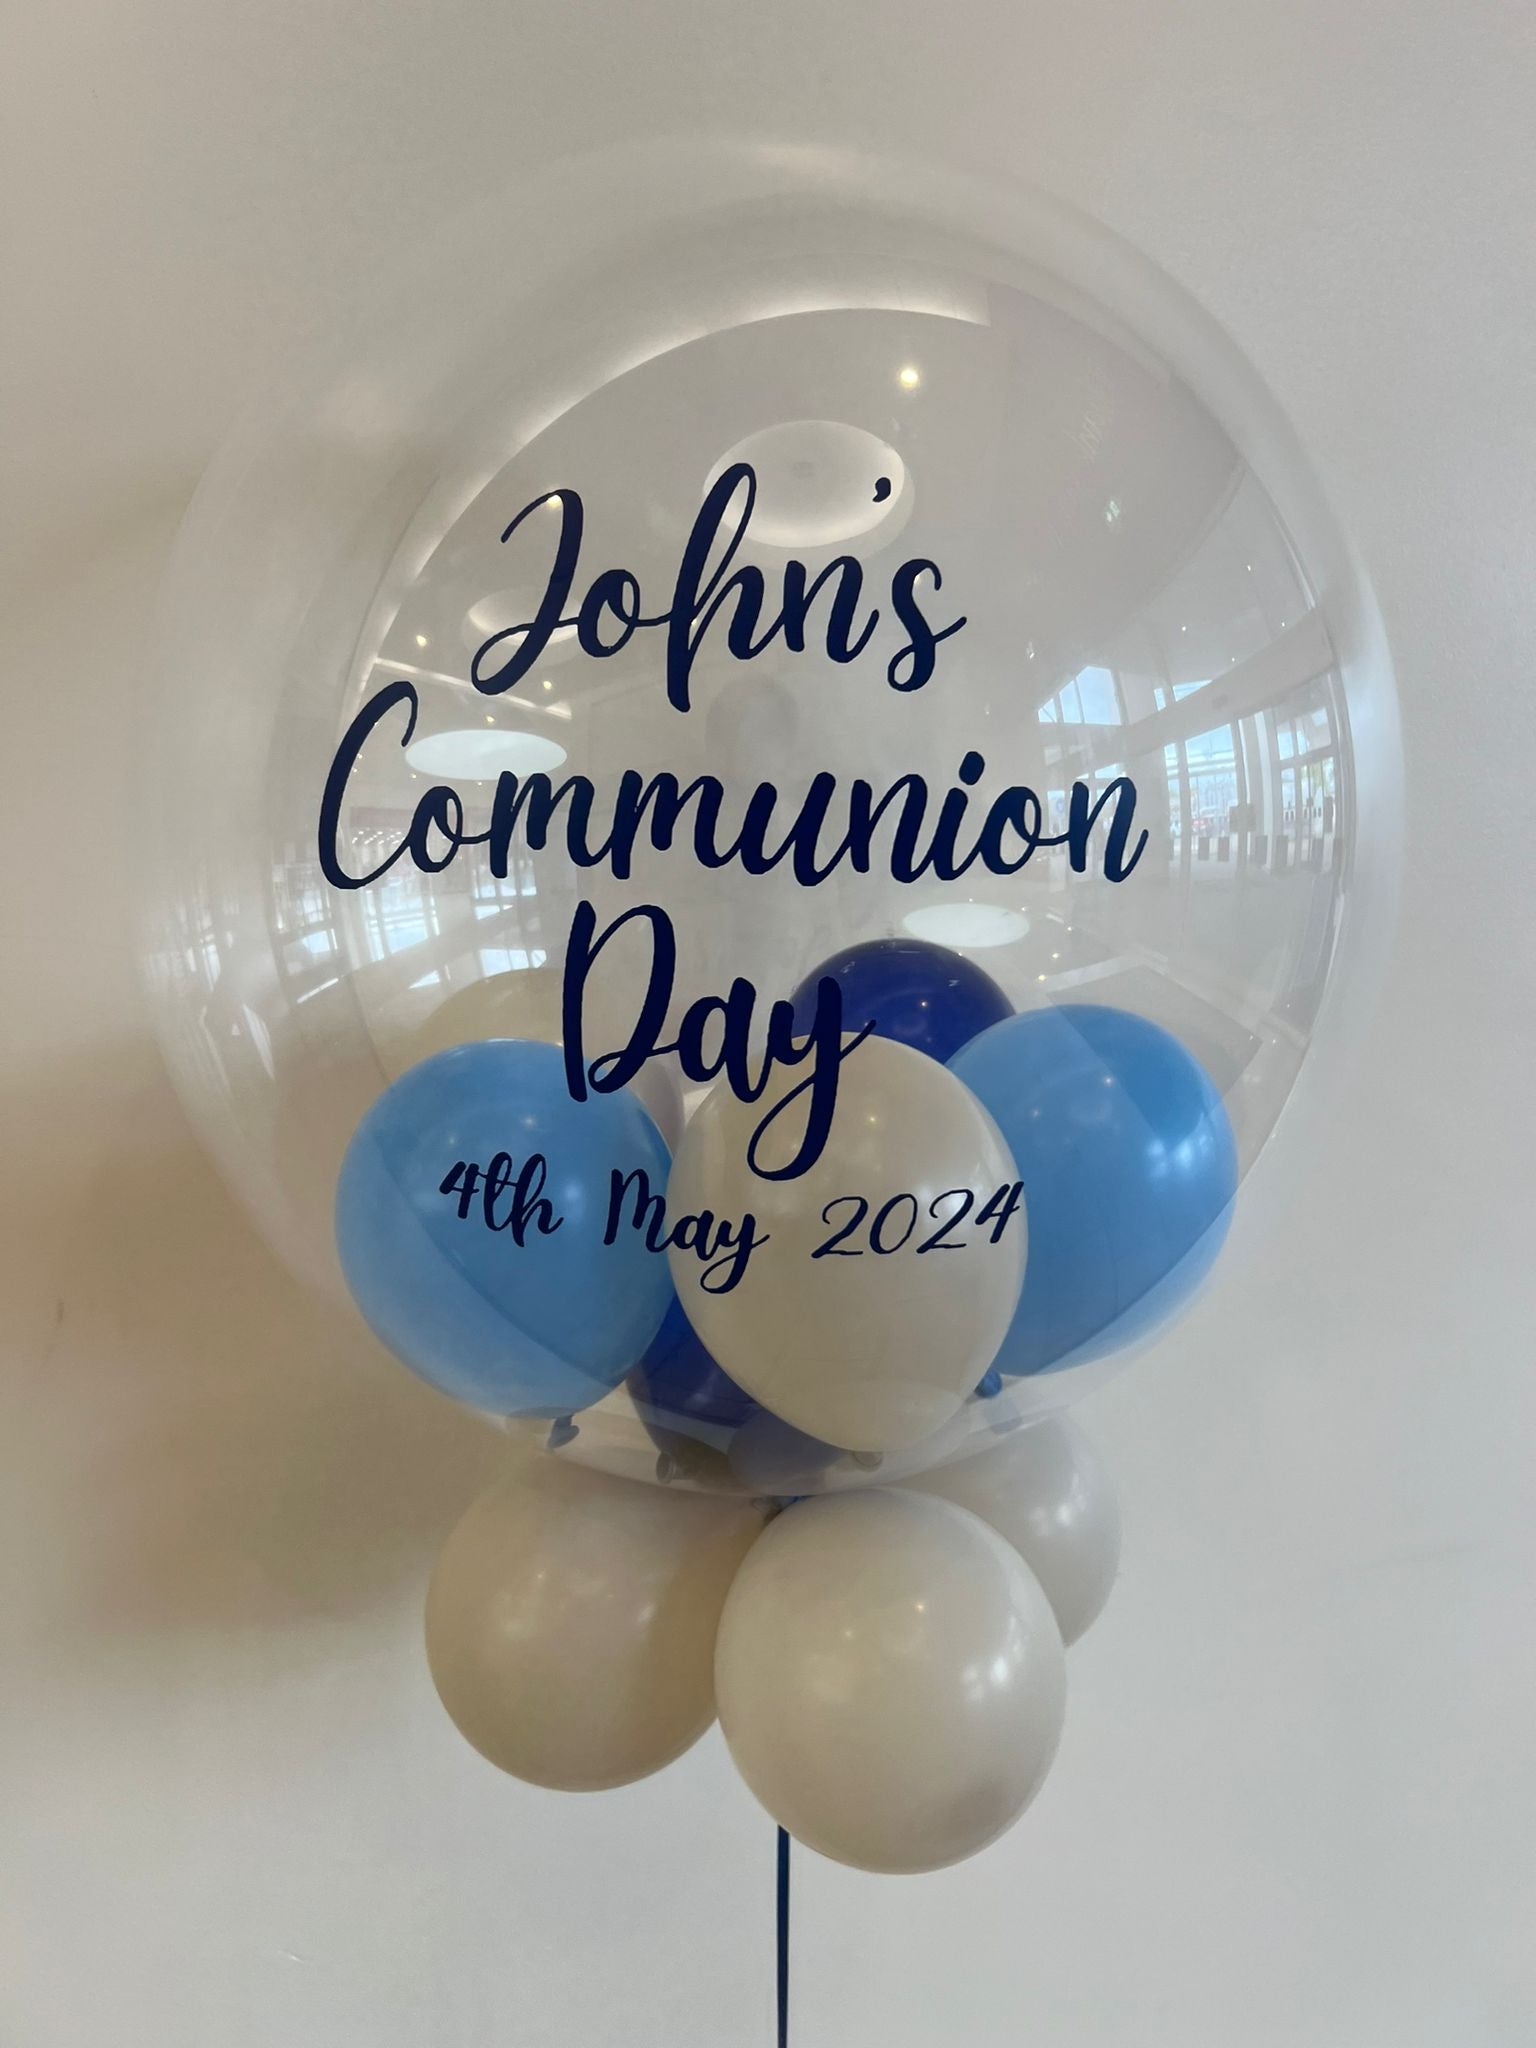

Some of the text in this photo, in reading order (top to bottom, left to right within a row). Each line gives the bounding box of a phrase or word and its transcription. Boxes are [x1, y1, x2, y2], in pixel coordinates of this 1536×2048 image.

[471, 462, 967, 713] John's
[318, 681, 1149, 890] Communion
[562, 900, 876, 1182] Day
[438, 1151, 1025, 1294] 4th May 2024
